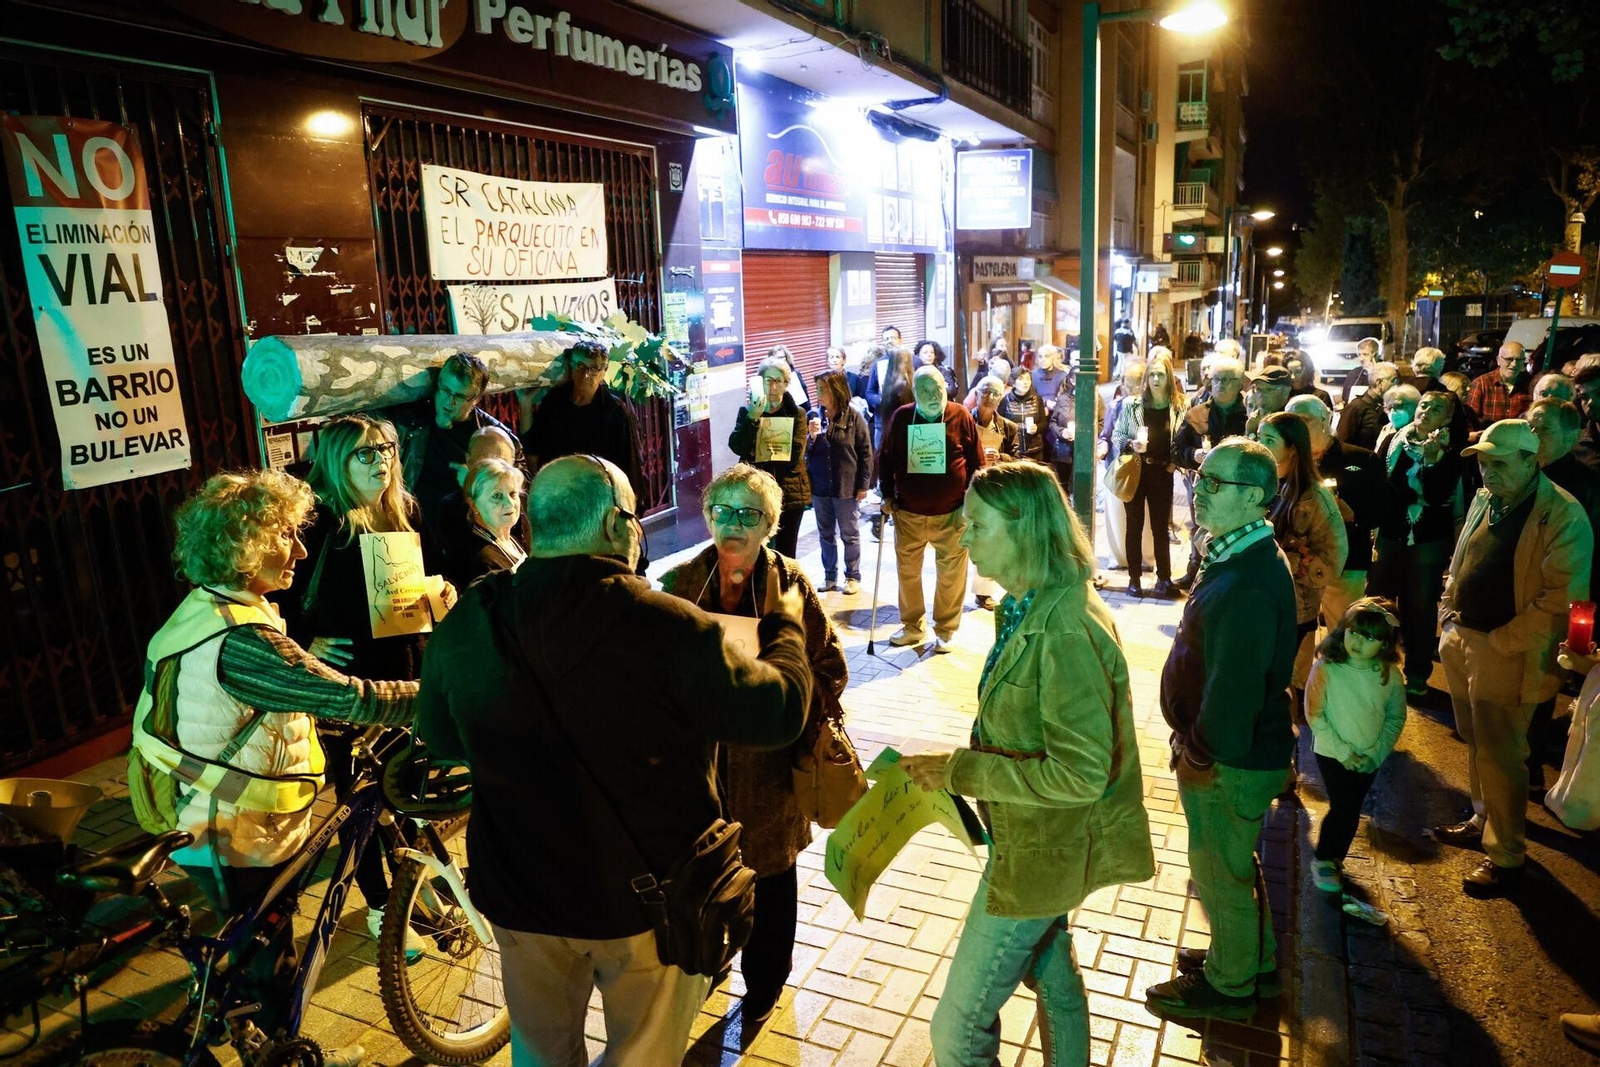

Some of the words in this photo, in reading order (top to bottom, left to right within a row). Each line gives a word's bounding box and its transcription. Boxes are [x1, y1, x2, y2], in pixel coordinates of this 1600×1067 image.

[15, 131, 135, 201] NO
[439, 174, 471, 208] SR
[26, 221, 152, 244] ELIMINACIÓN
[441, 216, 465, 245] EL
[475, 218, 574, 249] PARQUECITO
[580, 226, 600, 250] EN
[466, 245, 493, 276] SU
[503, 249, 579, 277] OFICINA
[975, 262, 1017, 277] PASTELERIA
[37, 252, 158, 307] VIAL
[87, 346, 117, 366] ES
[121, 343, 149, 362] UN
[55, 368, 174, 407] BARRIO
[95, 411, 128, 431] NO
[133, 405, 159, 425] UN
[70, 428, 185, 466] BULEVAR
